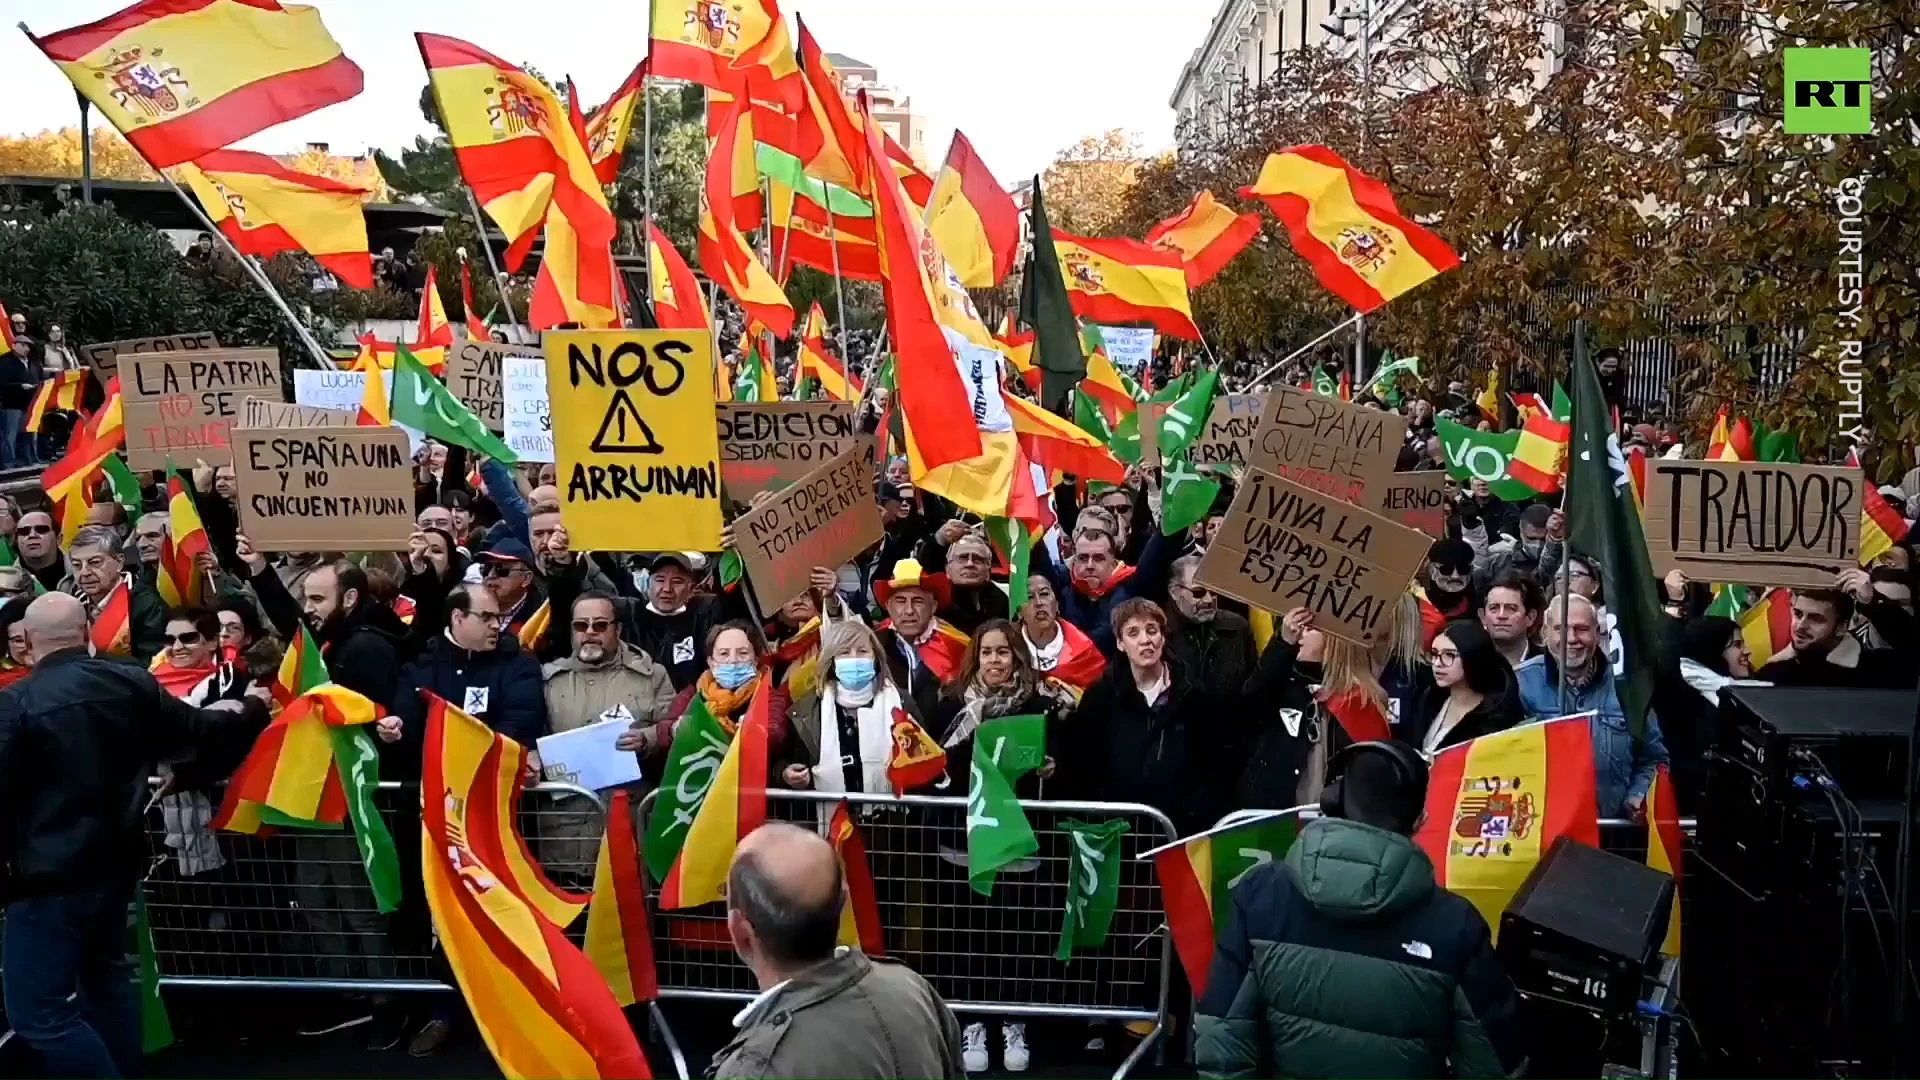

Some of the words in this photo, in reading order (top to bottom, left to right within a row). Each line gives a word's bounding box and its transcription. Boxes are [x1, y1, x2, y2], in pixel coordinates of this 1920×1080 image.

[135, 361, 180, 396] LA
[190, 360, 277, 391] PATRIA
[568, 339, 693, 396] NOS
[158, 392, 193, 421] NO
[201, 392, 236, 417] SE
[716, 404, 853, 441] SEDICIÓN
[1275, 389, 1384, 453] ESPAÑA
[248, 435, 359, 471] ESPAÑA
[361, 443, 403, 469] UNA
[1262, 428, 1370, 480] QUIERE
[1445, 437, 1513, 482] VO
[278, 470, 289, 492] Y
[304, 470, 329, 488] NO
[567, 460, 717, 503] ARRUINAN
[1382, 485, 1442, 510] IERNO
[750, 508, 779, 541] NO
[781, 478, 829, 518] TODO
[758, 479, 868, 561] TOTALMENTE
[1656, 466, 1855, 556] TRAIDOR.
[1243, 517, 1328, 569] UNIDAD
[1334, 555, 1370, 590] DE
[1330, 515, 1373, 554] LA
[1239, 547, 1386, 640] ESPAÑA!
[1583, 977, 1607, 999] 16
